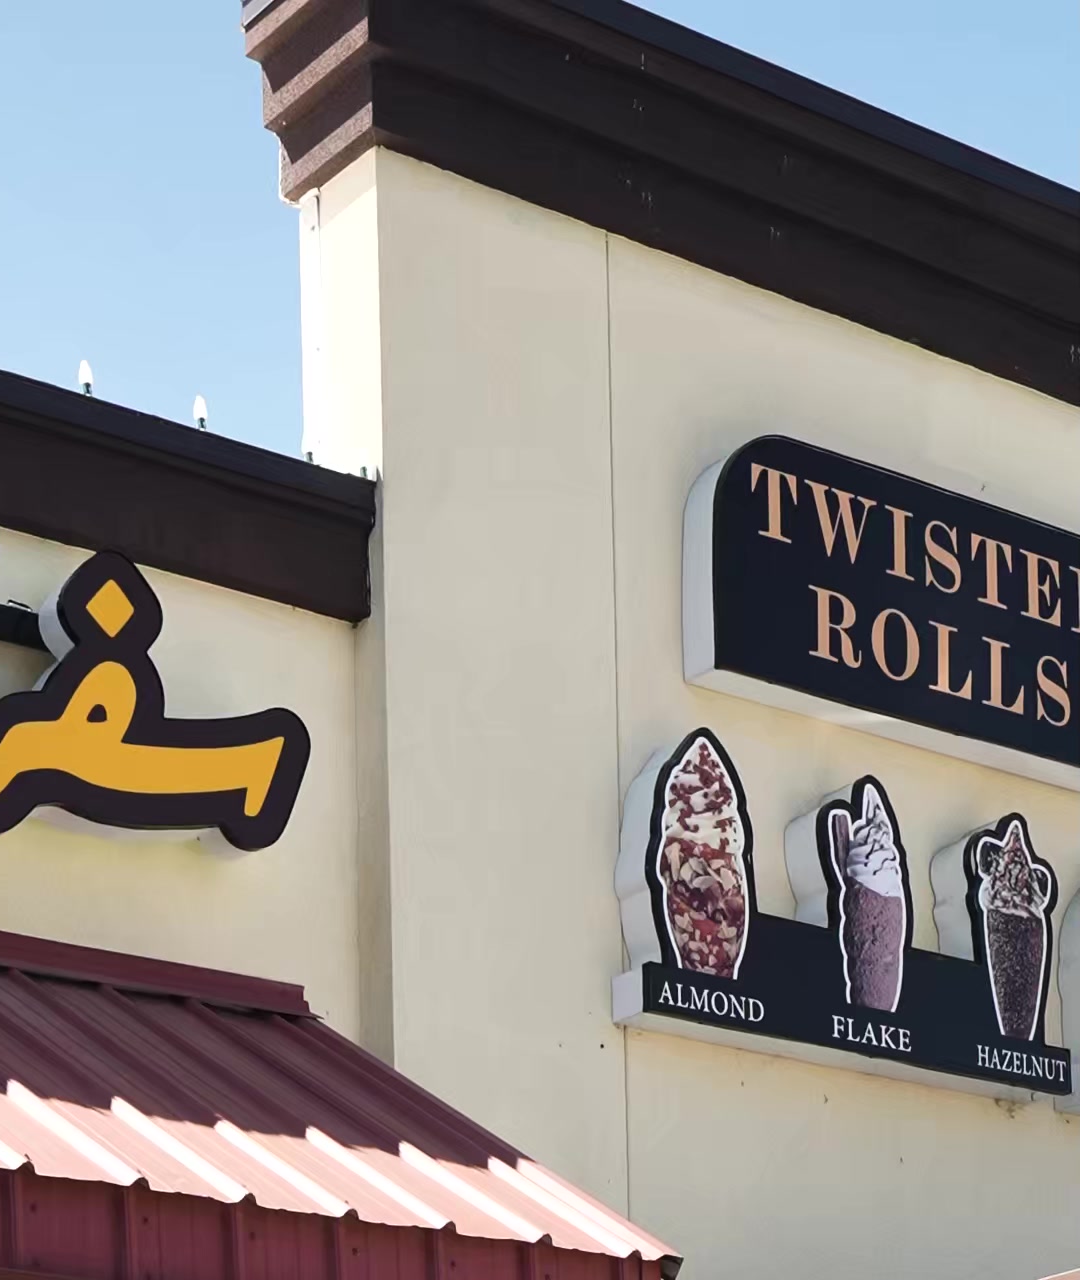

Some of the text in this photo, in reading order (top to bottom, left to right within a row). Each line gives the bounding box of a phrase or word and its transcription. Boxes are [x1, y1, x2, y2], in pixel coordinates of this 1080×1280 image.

[751, 463, 1080, 634] TWISTE
[808, 584, 1071, 727] ROLLS
[659, 981, 764, 1022] ALMOND
[832, 1015, 912, 1052] FLAKE
[977, 1044, 1067, 1083] HAZELNUT
